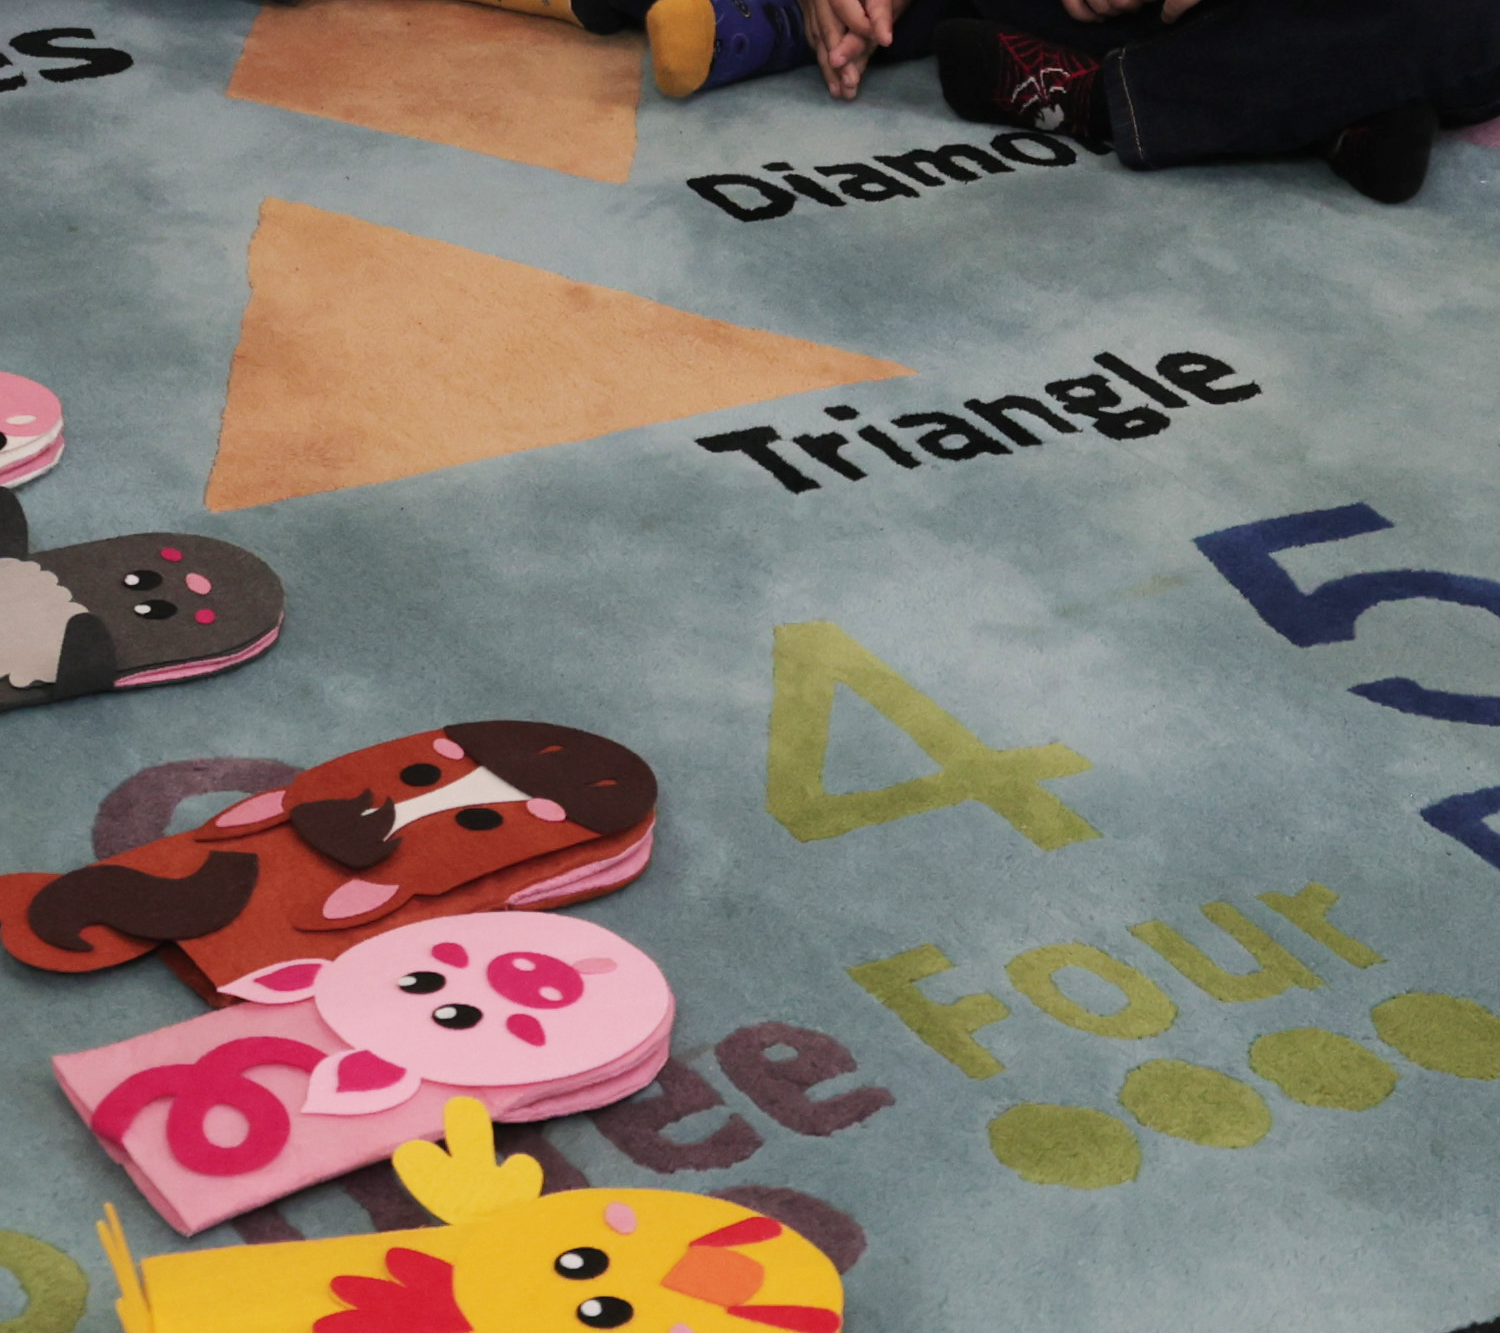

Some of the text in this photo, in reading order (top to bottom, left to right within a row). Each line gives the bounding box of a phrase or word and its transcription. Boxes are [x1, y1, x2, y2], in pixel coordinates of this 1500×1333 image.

[687, 132, 1118, 223] Diamo
[695, 350, 1263, 494] Triangle
[765, 620, 1105, 852] 4
[846, 881, 1385, 1081] Four
